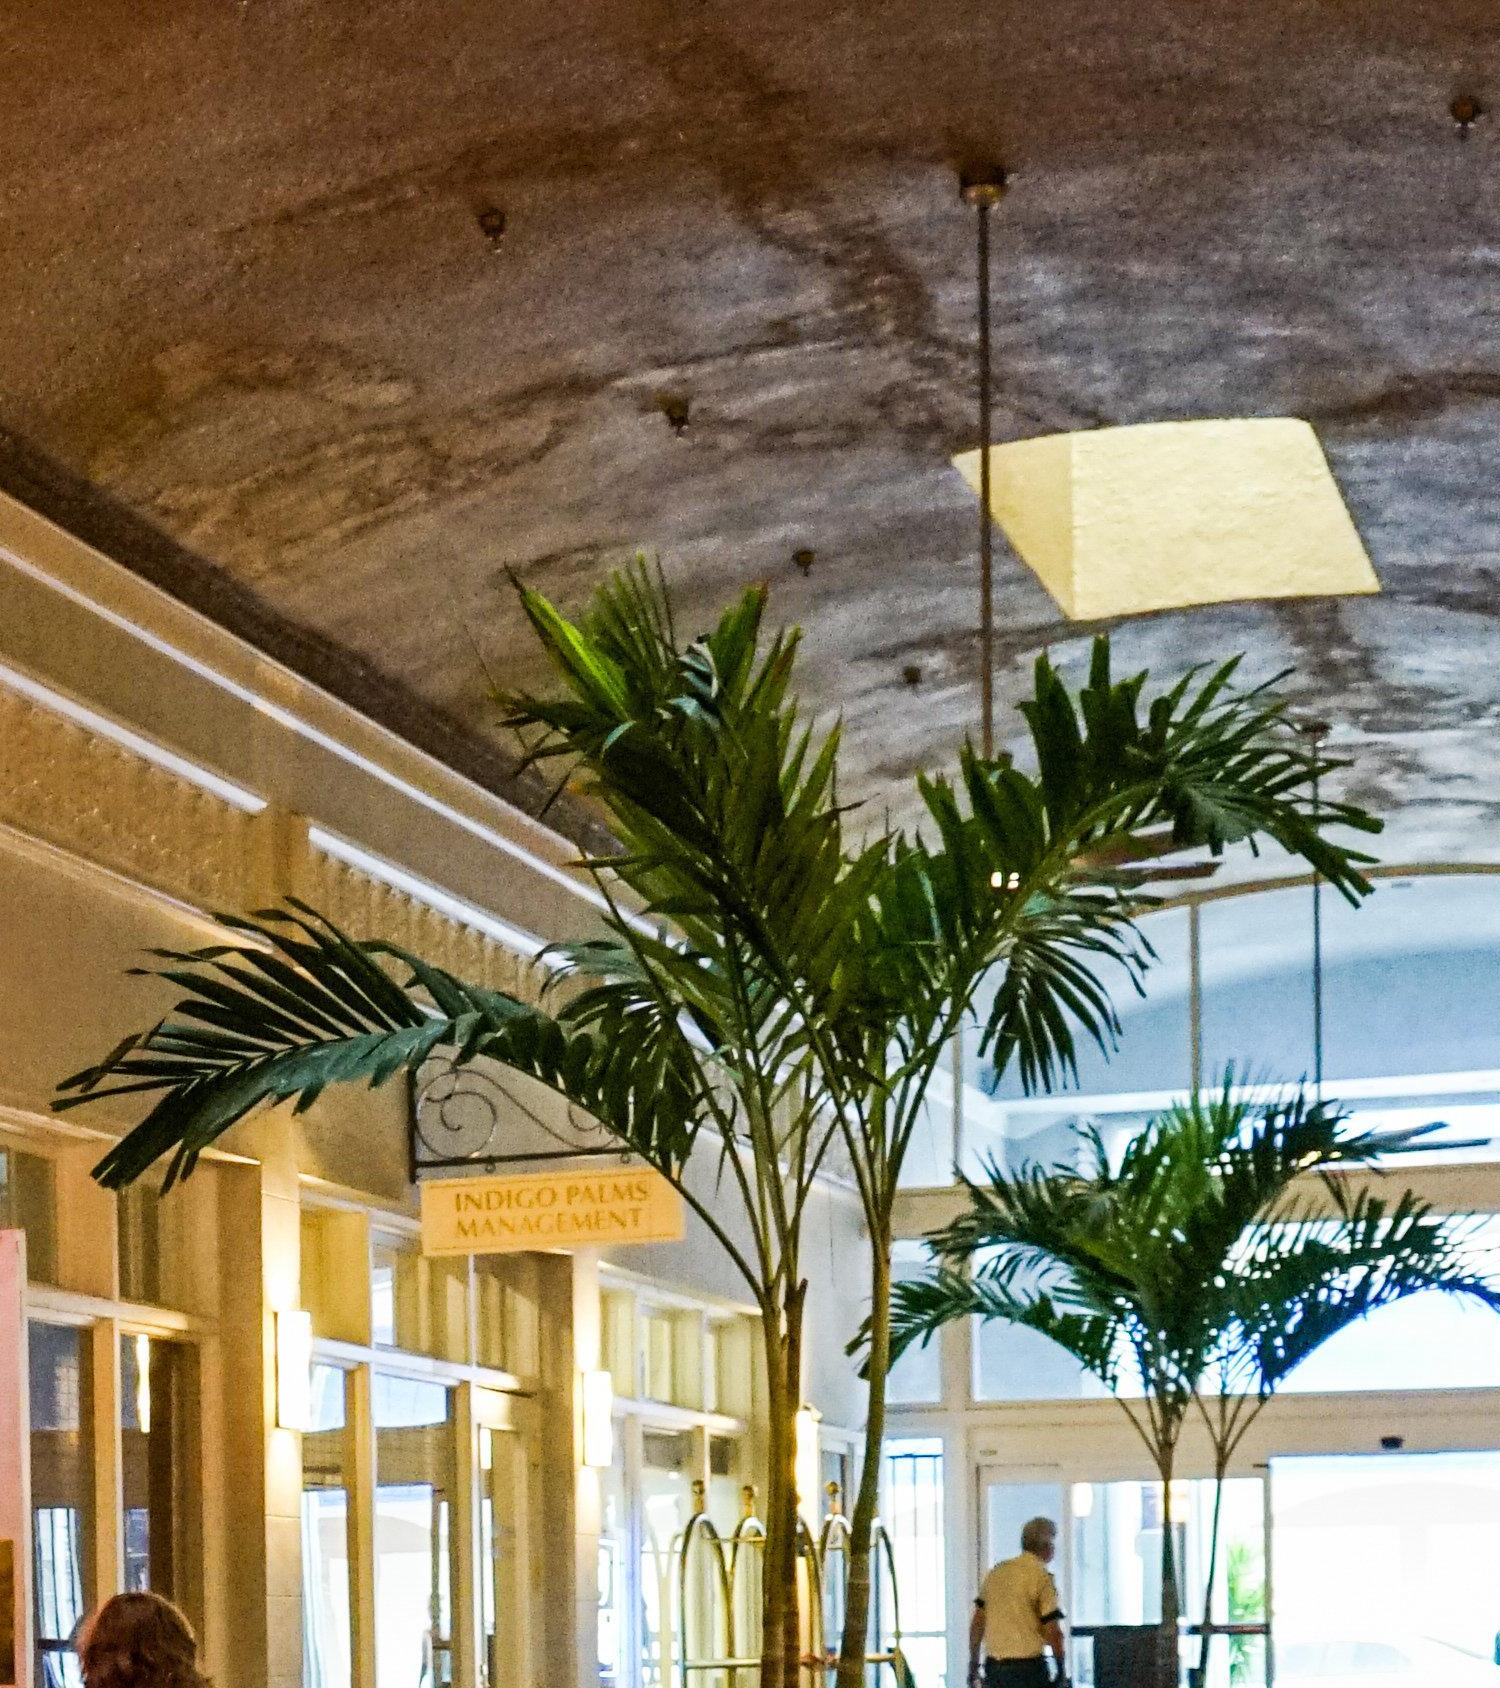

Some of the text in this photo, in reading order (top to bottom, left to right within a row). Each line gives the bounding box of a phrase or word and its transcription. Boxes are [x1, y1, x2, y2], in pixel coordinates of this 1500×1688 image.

[455, 1180, 650, 1213] INDIGO PALMS
[456, 1208, 643, 1239] MANAGEMENT
